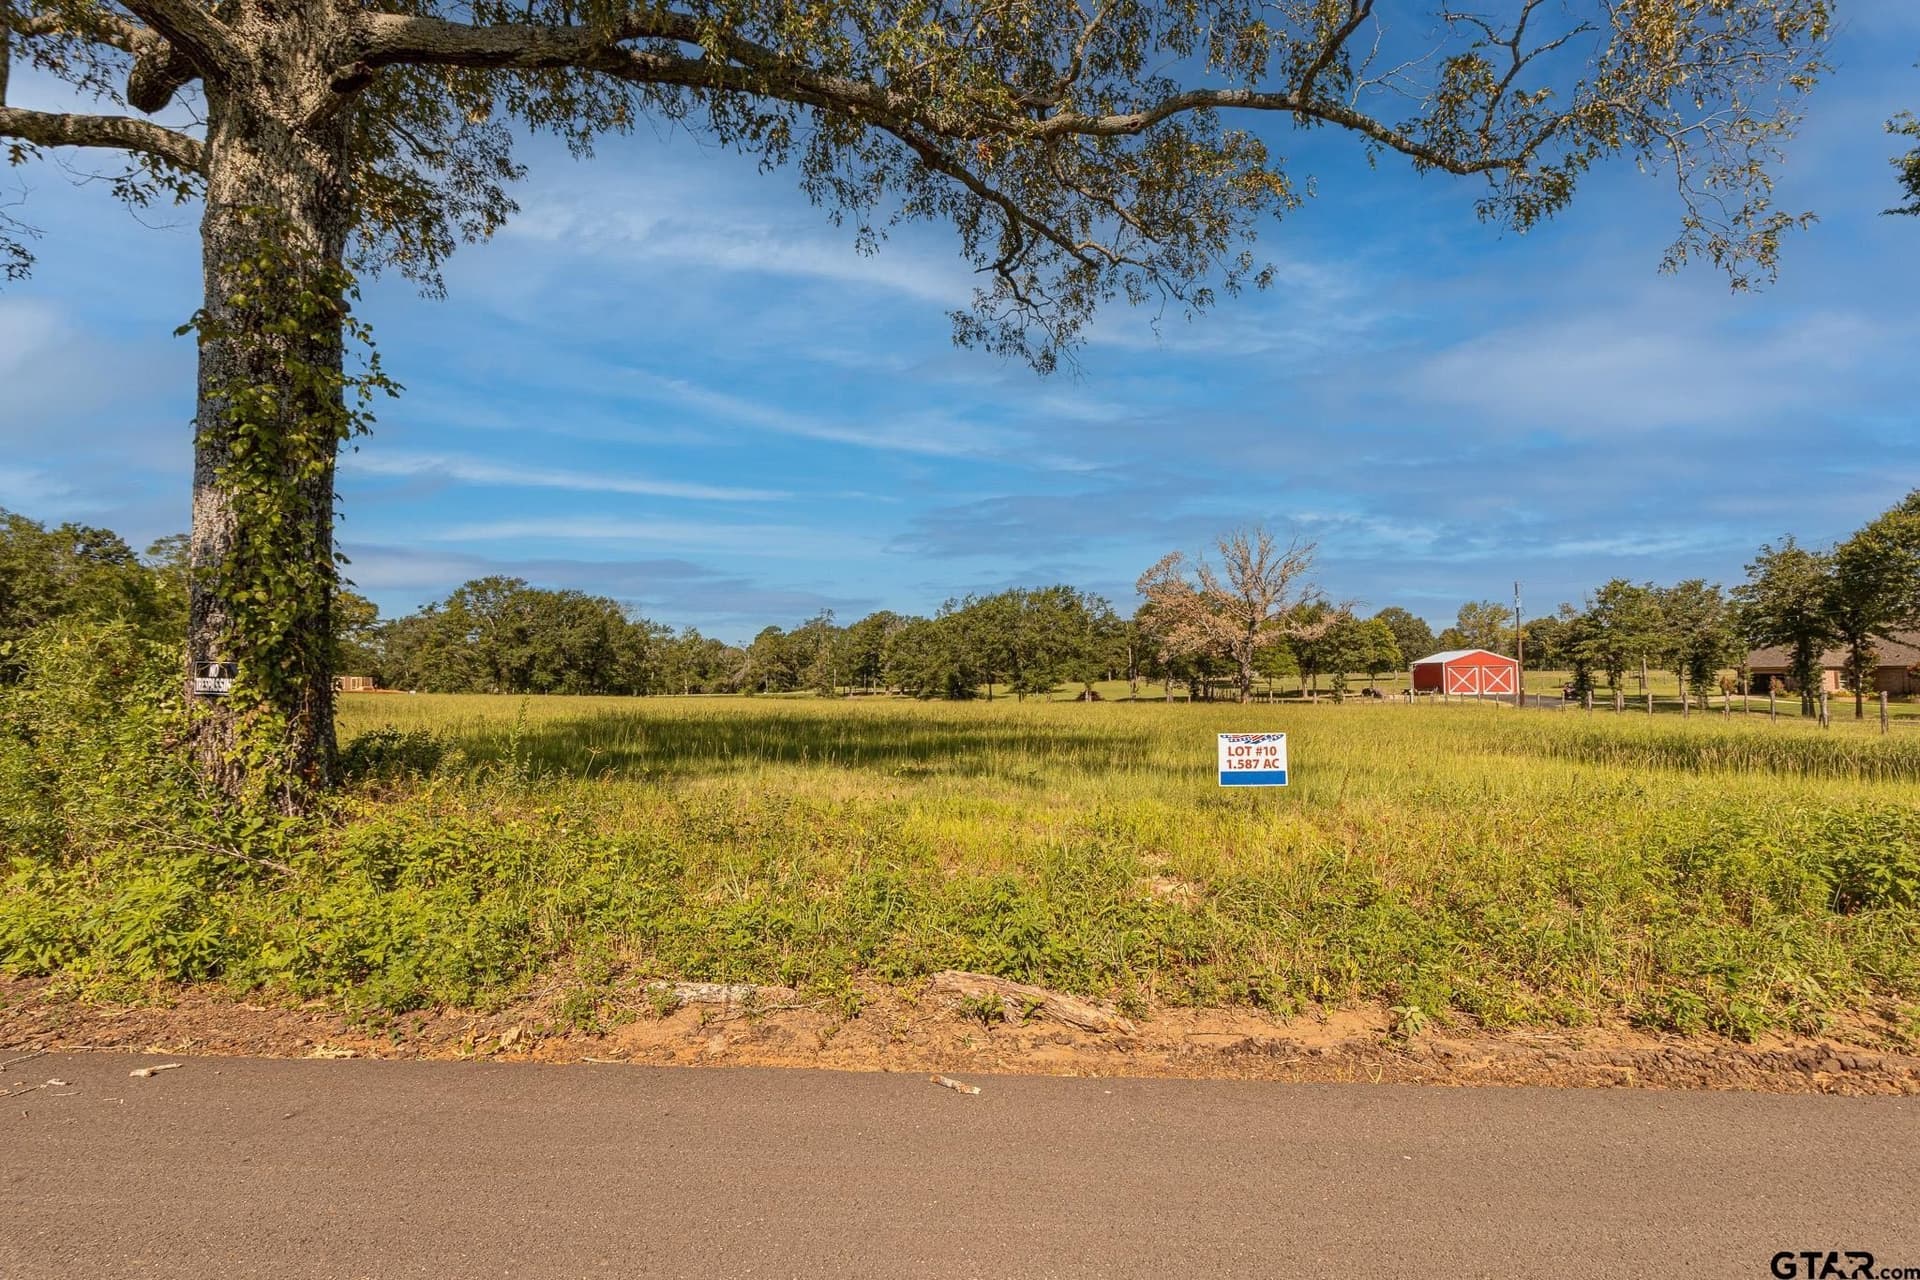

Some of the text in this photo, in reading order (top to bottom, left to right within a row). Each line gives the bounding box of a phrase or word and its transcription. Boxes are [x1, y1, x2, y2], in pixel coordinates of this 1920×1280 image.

[208, 664, 220, 678] NO
[195, 677, 233, 692] TRESPASSIN
[1228, 746, 1277, 757] LOT #10
[1227, 758, 1280, 769] 1.587 AC
